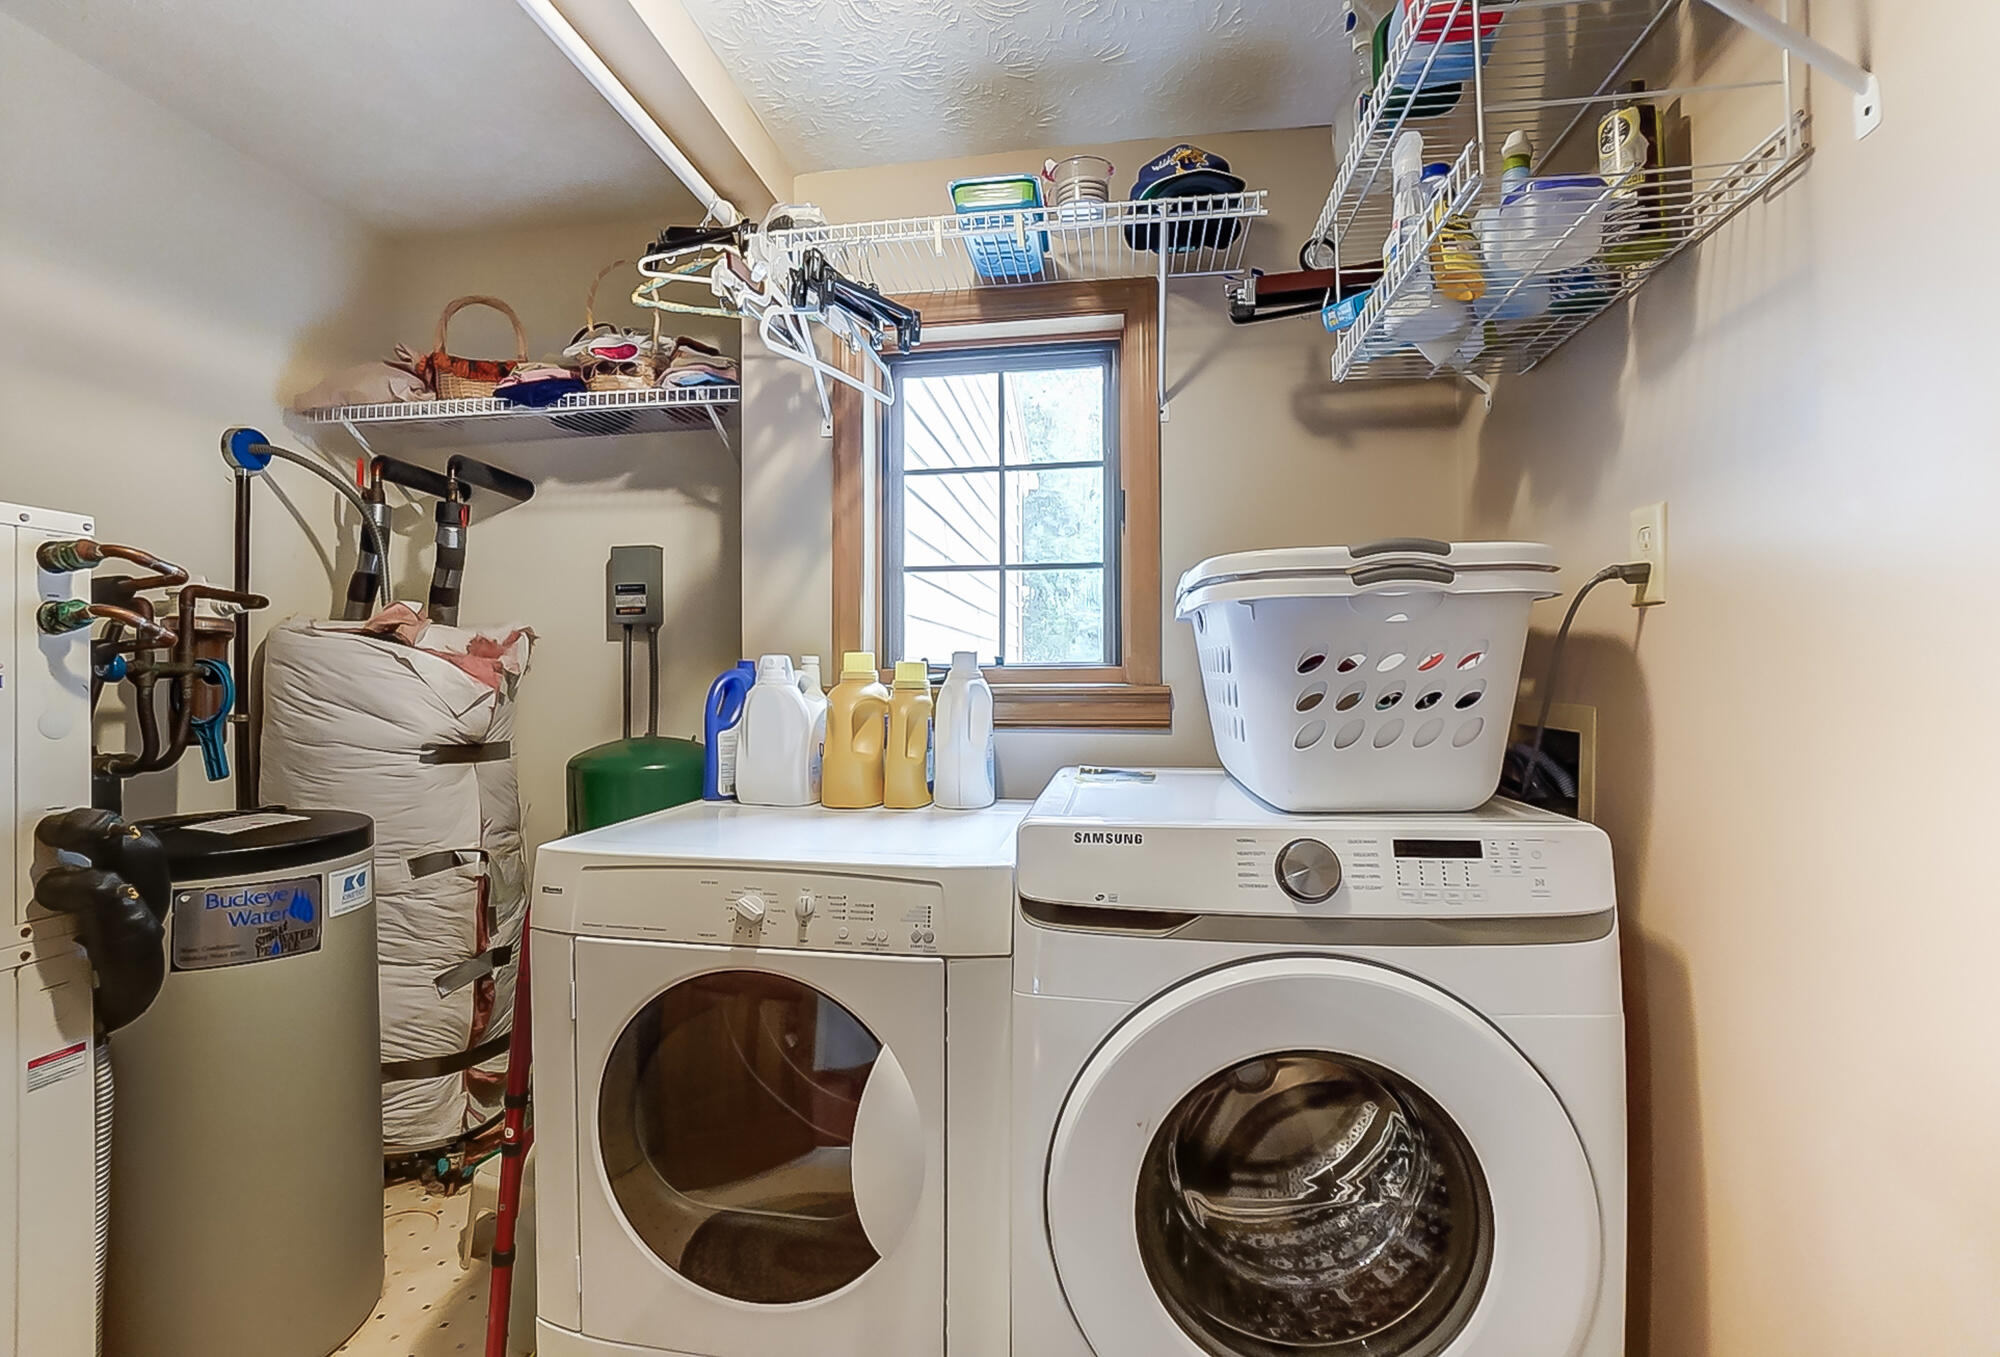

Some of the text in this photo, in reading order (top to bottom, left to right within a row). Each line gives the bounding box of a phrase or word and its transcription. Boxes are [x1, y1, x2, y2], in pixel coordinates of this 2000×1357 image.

[1074, 832, 1143, 844] SAMSUNG
[205, 889, 289, 910] Buckeye
[227, 907, 290, 928] Water
[280, 928, 314, 946] WATER
